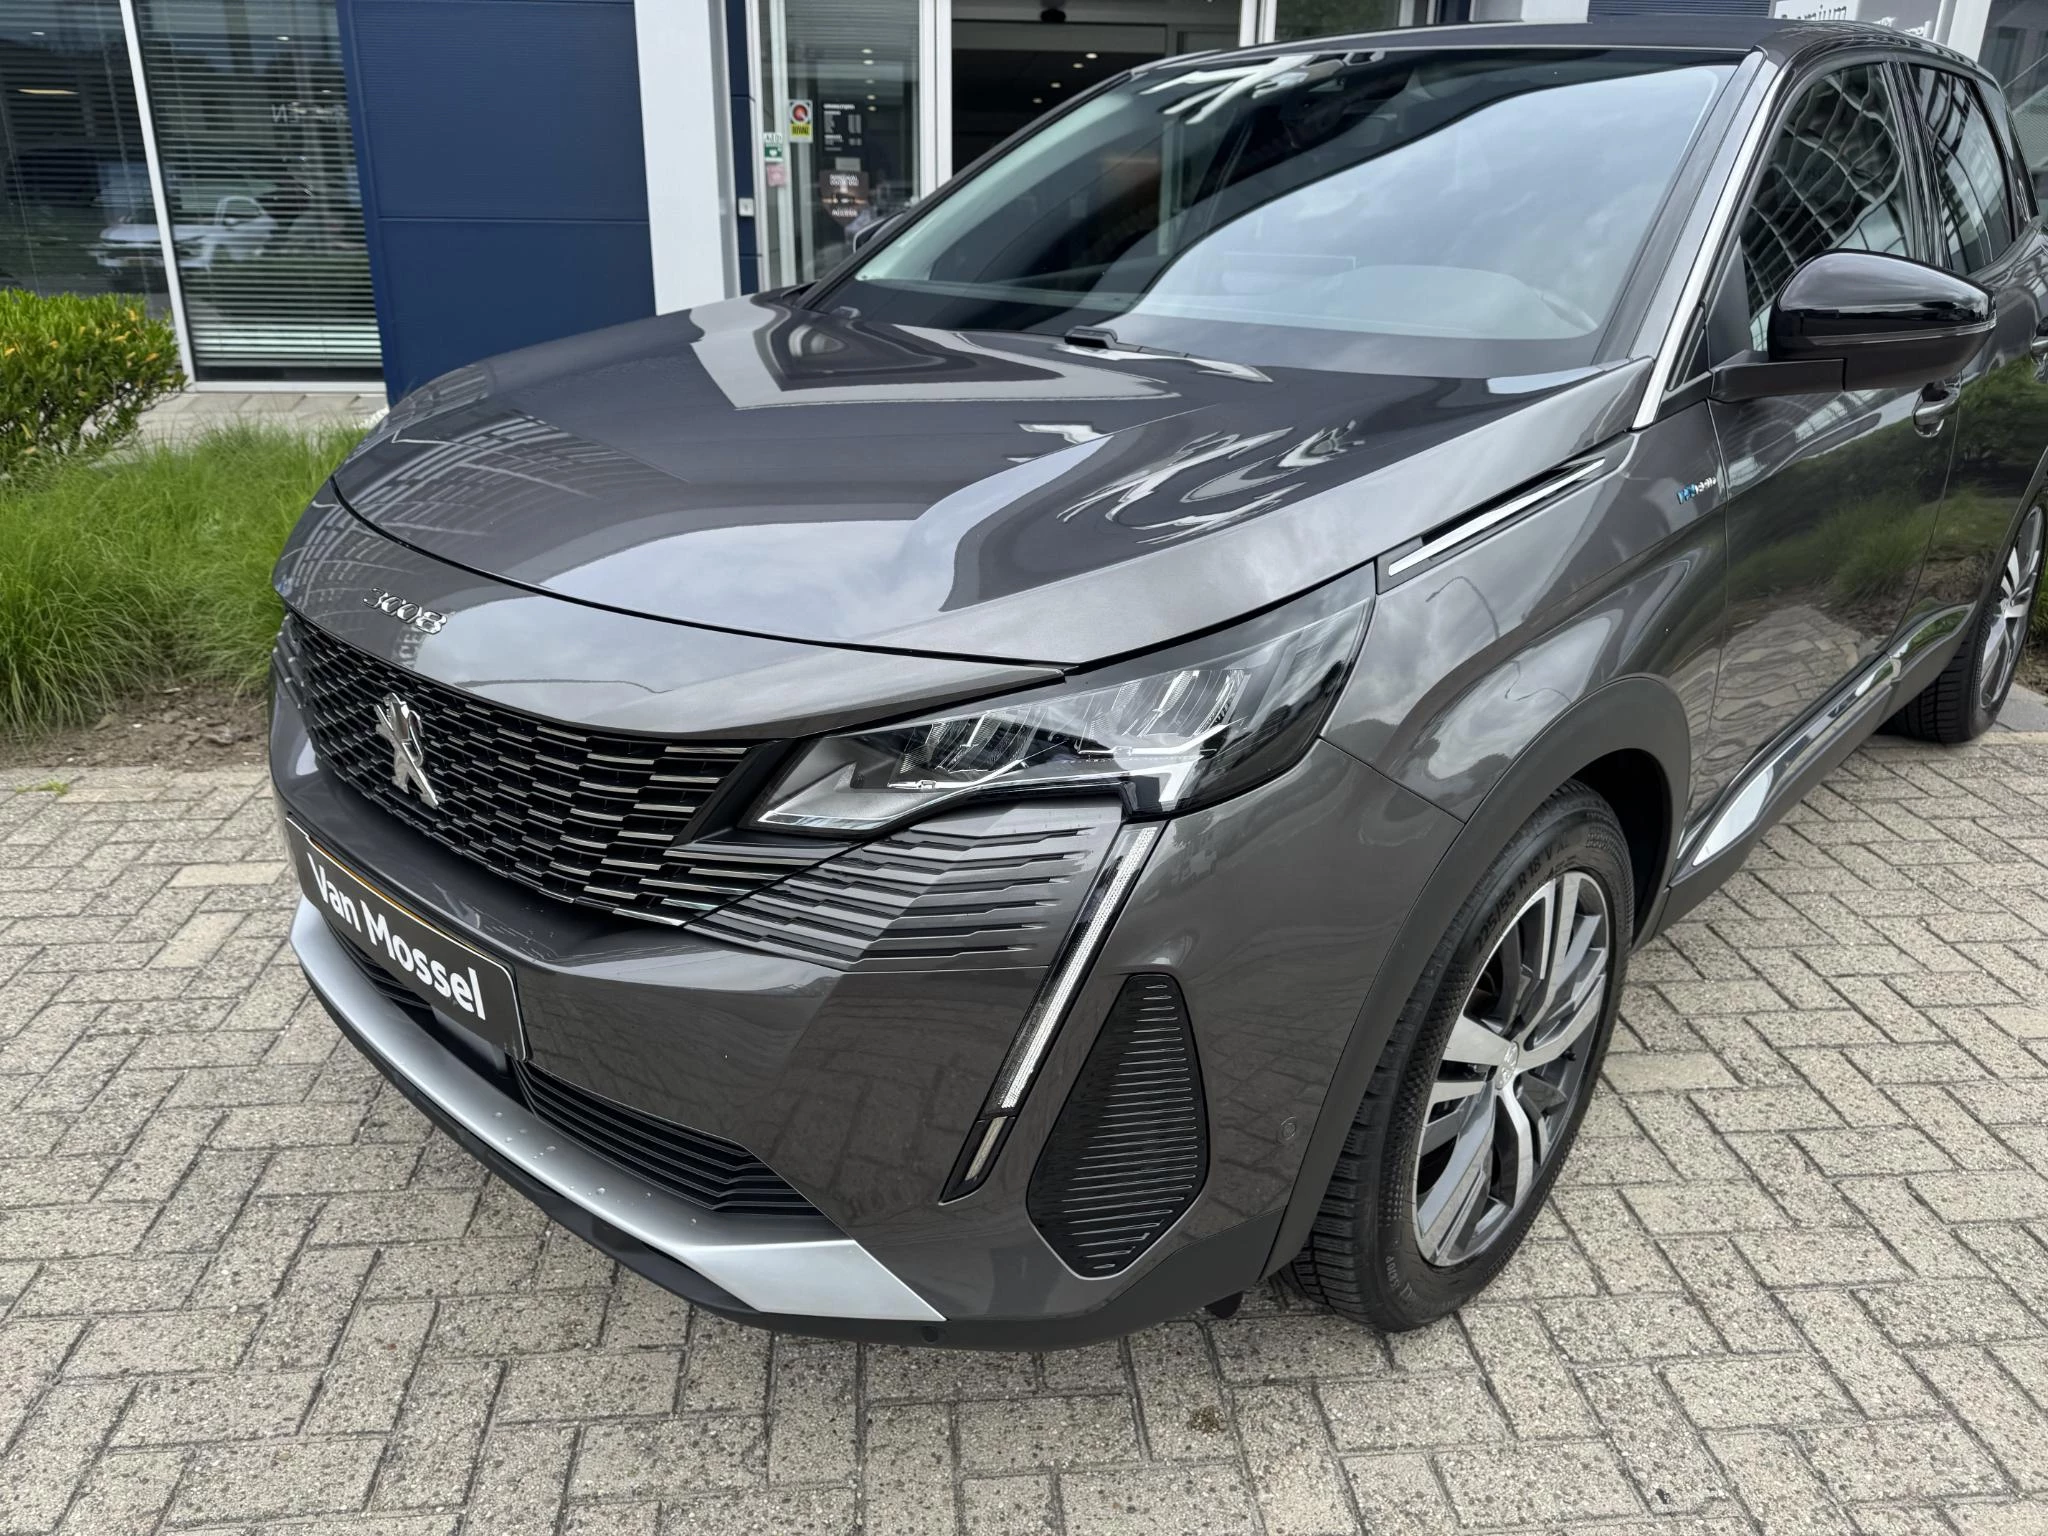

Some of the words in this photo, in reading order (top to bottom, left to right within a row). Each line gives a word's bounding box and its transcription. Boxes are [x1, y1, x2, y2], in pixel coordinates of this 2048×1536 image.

[362, 588, 447, 635] 3008
[307, 852, 362, 933] Van
[360, 900, 486, 1021] Mossel
